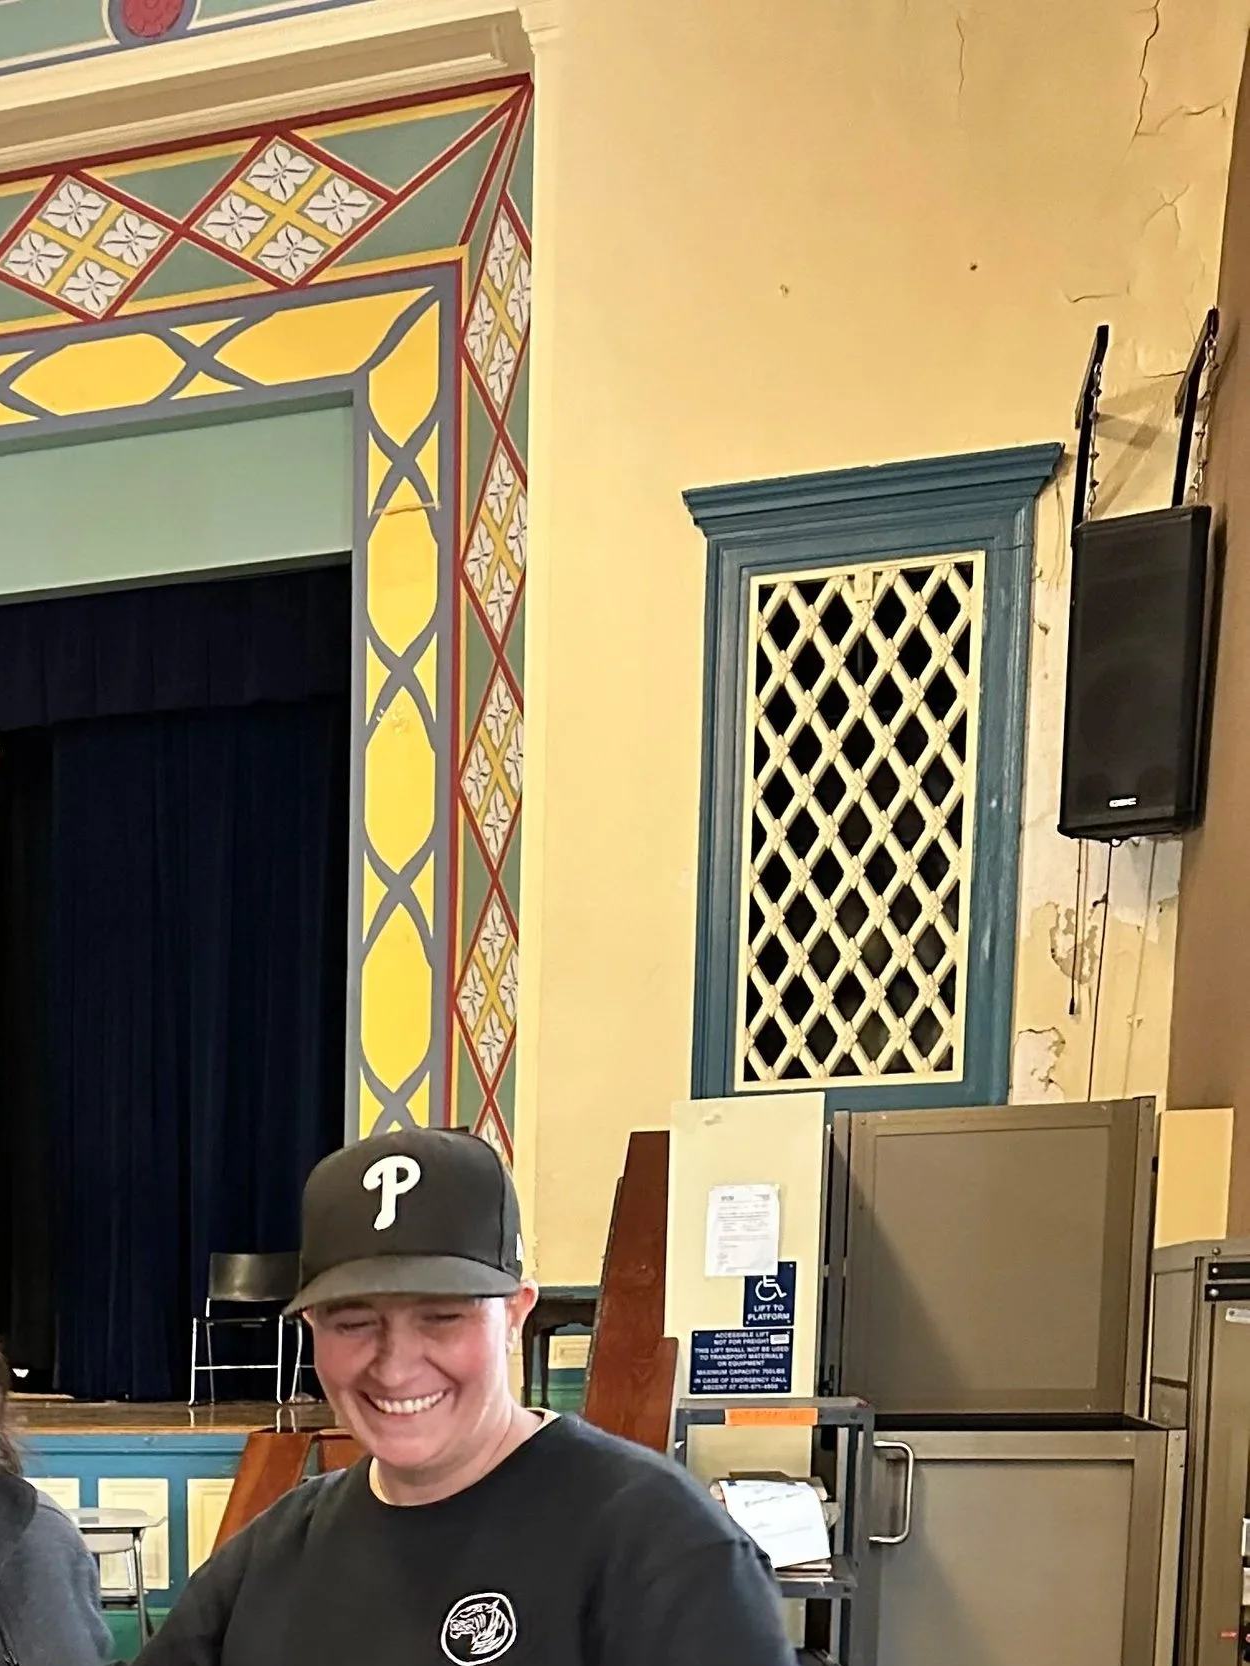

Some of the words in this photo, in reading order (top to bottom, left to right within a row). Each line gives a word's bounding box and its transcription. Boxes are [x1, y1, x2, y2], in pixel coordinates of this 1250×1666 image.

[362, 1155, 421, 1231] P
[753, 1304, 771, 1312] LIFT
[773, 1304, 785, 1312] TO
[747, 1313, 790, 1321] PLATFORM
